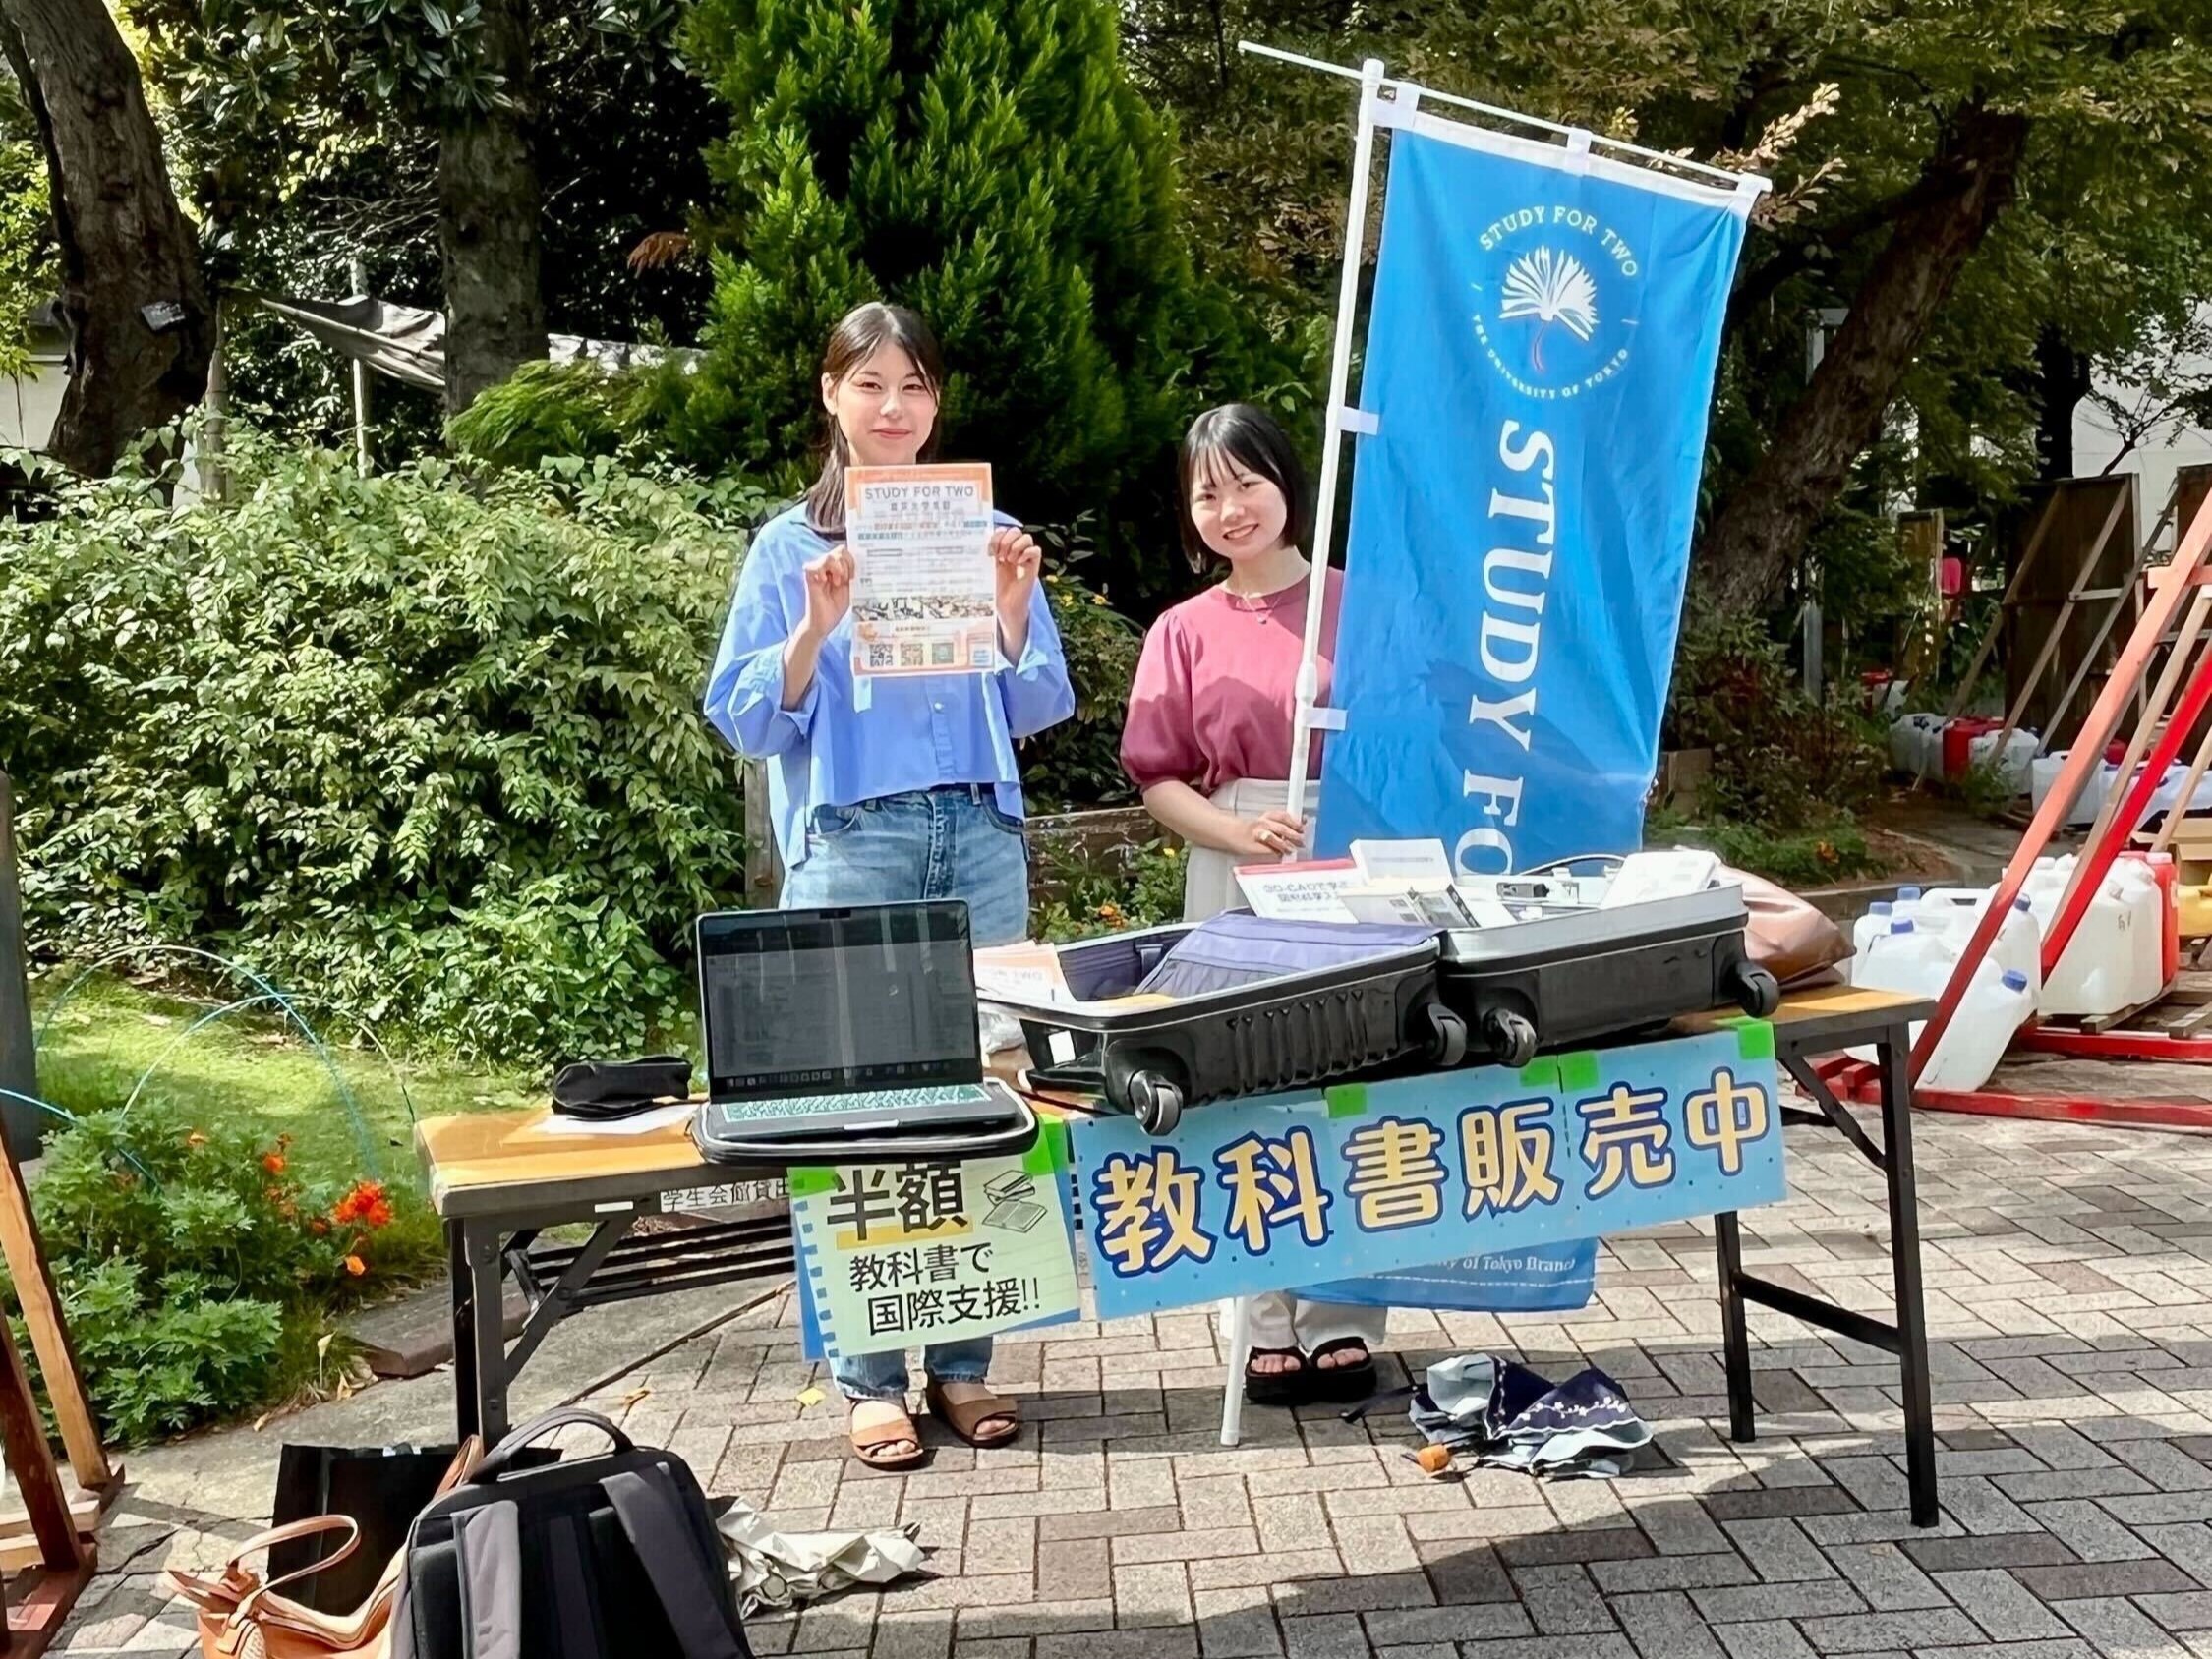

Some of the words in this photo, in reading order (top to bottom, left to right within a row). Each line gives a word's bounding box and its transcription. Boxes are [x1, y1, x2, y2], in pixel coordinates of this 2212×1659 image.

[1479, 205, 1545, 251] STUDY
[1552, 205, 1598, 235] FOR
[1601, 228, 1638, 276] TWO
[1473, 314, 1489, 345] THE
[1487, 348, 1556, 399] UNIVERSITY
[1561, 384, 1580, 398] OF
[1585, 348, 1628, 388] TOKYO
[865, 486, 908, 499] STUDY
[913, 486, 941, 497] FOR
[945, 486, 974, 497] TWO
[1468, 419, 1556, 752] STUDY
[1454, 768, 1525, 876] FO
[827, 1162, 969, 1240] 半額
[1089, 1065, 1775, 1278] 教科書販売中
[849, 1241, 994, 1292] 教科書で
[1462, 1256, 1479, 1271] of
[1483, 1255, 1523, 1274] Tokyo
